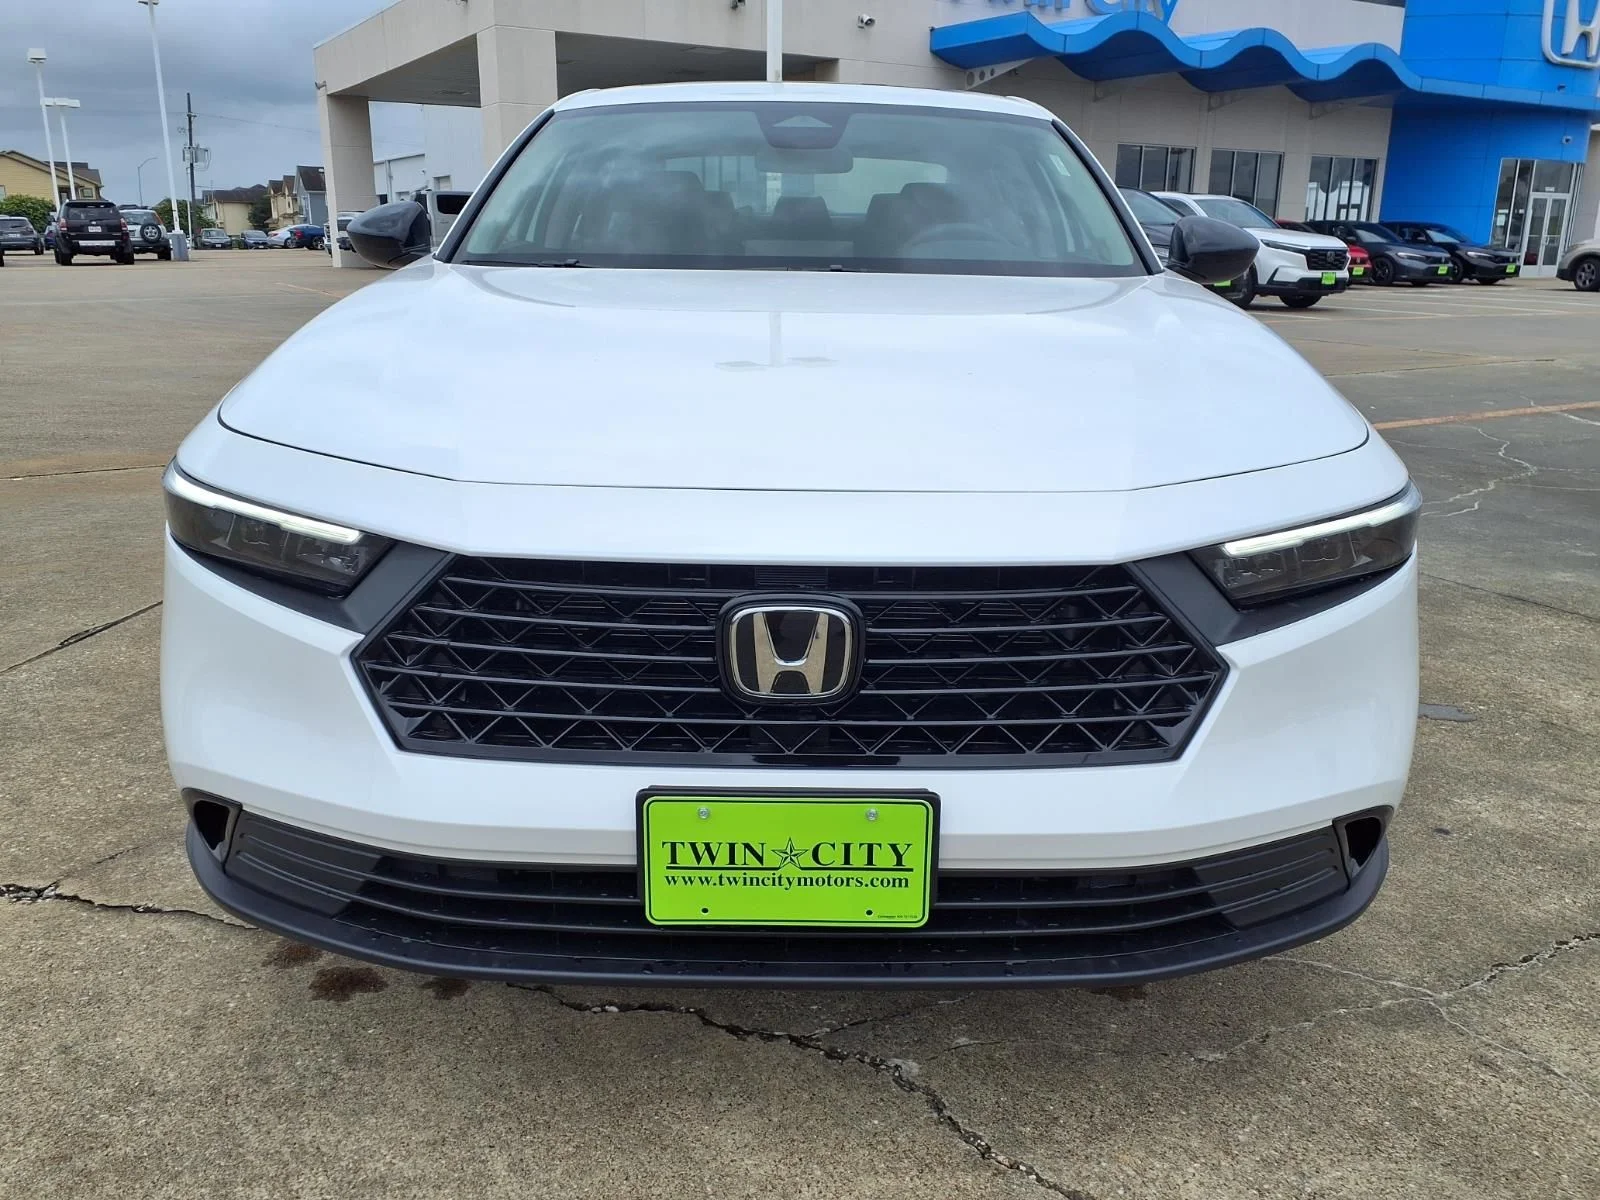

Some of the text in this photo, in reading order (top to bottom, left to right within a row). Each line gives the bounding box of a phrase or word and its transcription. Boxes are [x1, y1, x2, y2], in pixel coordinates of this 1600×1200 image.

[661, 841, 913, 867] TWIN CITY
[664, 871, 910, 891] www.twincitymotors.com
